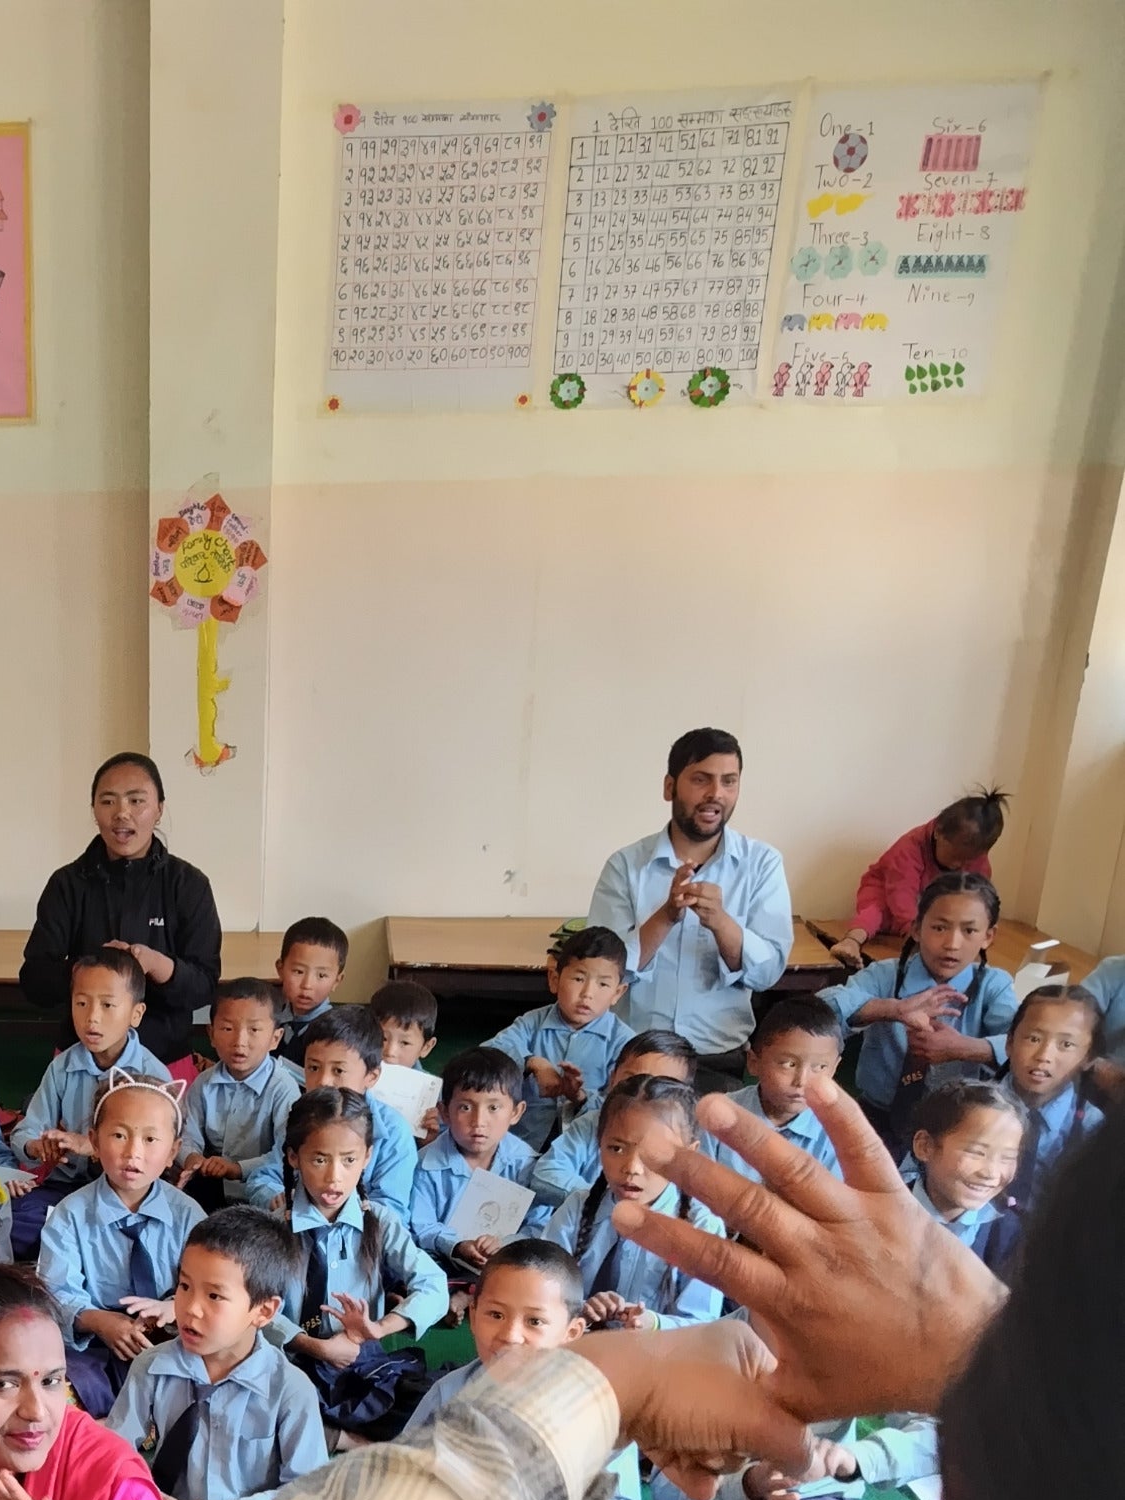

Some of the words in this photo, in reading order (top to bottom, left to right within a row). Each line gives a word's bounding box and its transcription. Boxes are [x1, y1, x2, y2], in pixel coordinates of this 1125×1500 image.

[651, 116, 673, 130] 100
[577, 142, 587, 160] 1
[597, 140, 609, 156] 11
[619, 136, 634, 154] 21
[639, 136, 651, 154] 31
[659, 135, 673, 152] 41
[681, 133, 695, 150] 51
[701, 131, 715, 148] 61
[726, 129, 739, 144] 71
[746, 128, 761, 147] 81
[766, 128, 779, 144] 91
[577, 168, 583, 182] 2
[595, 166, 609, 183] 12
[615, 165, 629, 182] 22
[636, 164, 649, 180] 32
[655, 164, 669, 179] 42
[679, 161, 693, 178] 52
[697, 160, 711, 176] 62
[722, 159, 735, 176] 72
[743, 158, 758, 178] 82
[763, 156, 775, 174] 92
[576, 193, 583, 206] 3
[593, 191, 606, 207] 13
[614, 190, 627, 205] 23
[633, 190, 647, 204] 33
[653, 189, 667, 204] 43
[675, 187, 691, 201] 53
[695, 184, 711, 201] 63
[719, 185, 732, 200] 73
[739, 184, 755, 200] 83
[761, 182, 775, 200] 93
[574, 216, 582, 229] 4
[593, 214, 605, 228] 14
[612, 212, 625, 227] 24
[631, 212, 645, 226] 34
[651, 212, 667, 228] 44
[673, 210, 689, 224] 54
[693, 208, 709, 223] 64
[717, 208, 732, 222] 74
[737, 206, 753, 223] 84
[758, 206, 772, 222] 94
[573, 237, 581, 252] 5
[590, 236, 604, 252] 15
[610, 234, 624, 251] 25
[629, 234, 643, 248] 35
[648, 232, 666, 249] 45
[670, 232, 687, 247] 55
[691, 231, 706, 245] 65
[715, 230, 729, 244] 75
[735, 229, 751, 245] 85
[755, 228, 769, 244] 95
